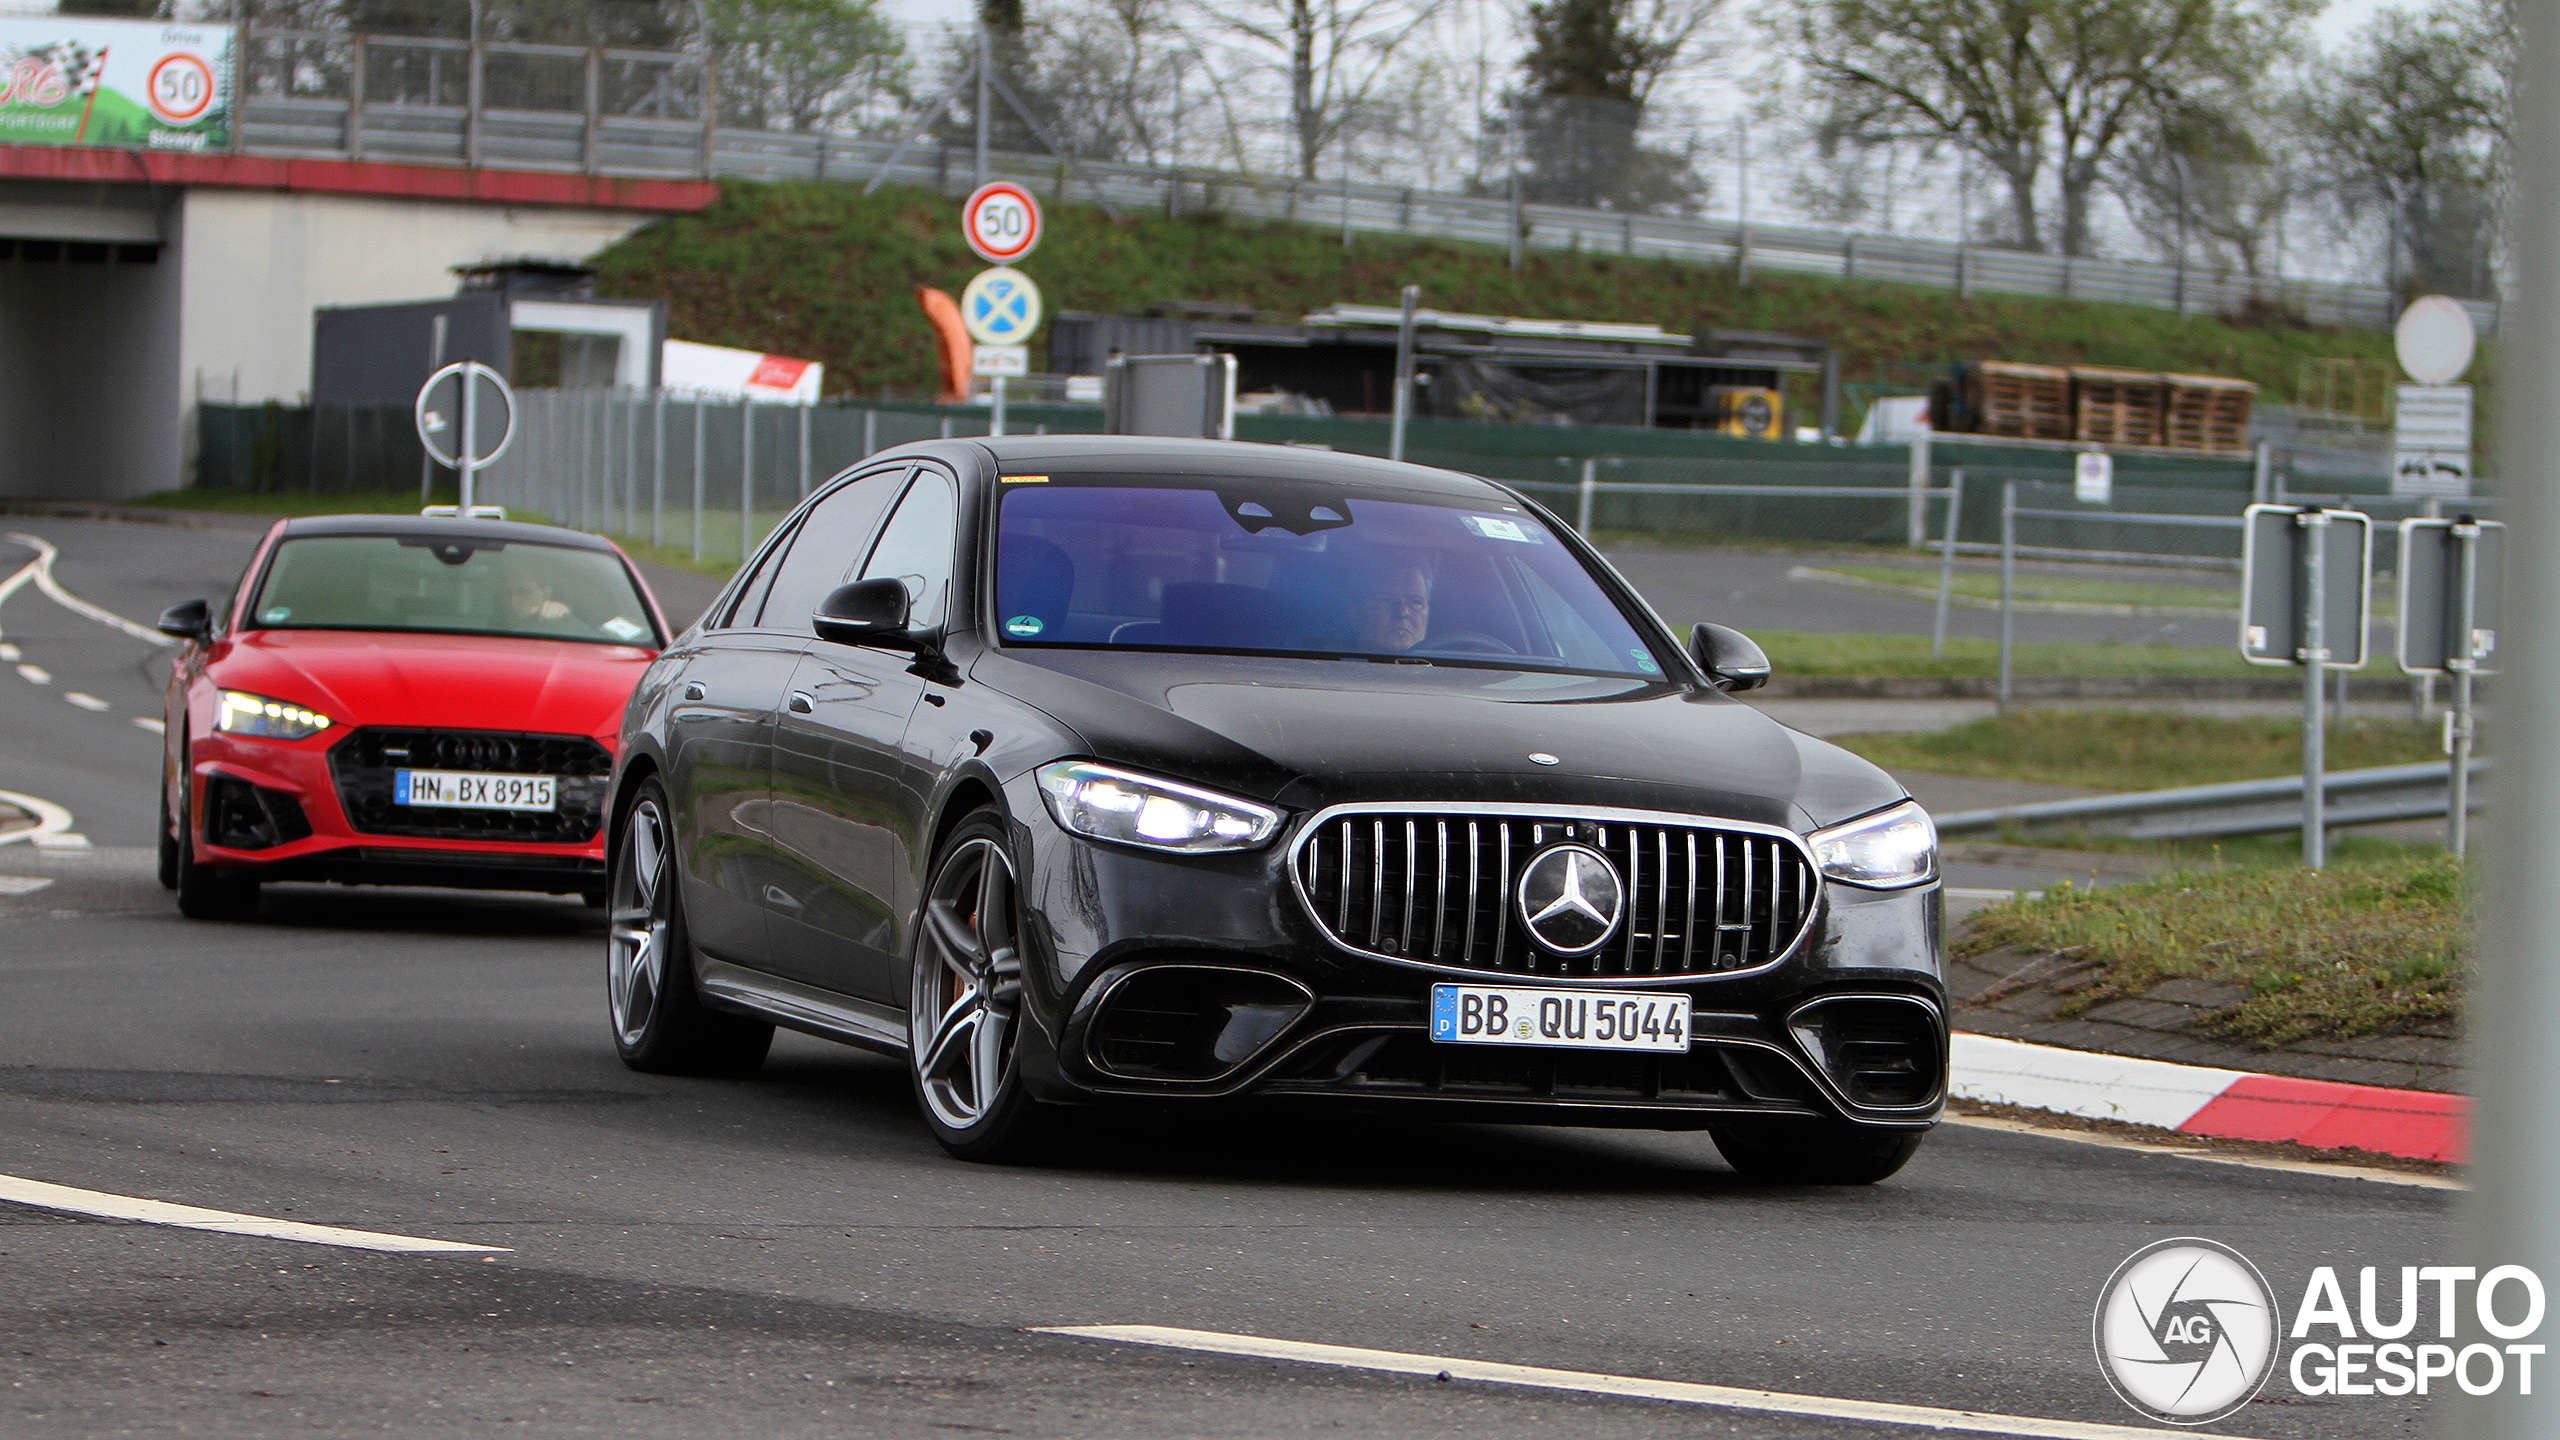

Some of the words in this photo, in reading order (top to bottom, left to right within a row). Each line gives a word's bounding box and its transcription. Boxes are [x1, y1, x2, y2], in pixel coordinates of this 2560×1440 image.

[162, 70, 199, 101] 50
[984, 205, 1022, 236] 50
[412, 776, 441, 800] HN
[459, 778, 489, 802] BX
[495, 779, 551, 805] 8915
[1439, 1019, 1450, 1032] D
[1461, 994, 1509, 1036] BB
[1540, 997, 1587, 1039] QU
[1596, 1000, 1683, 1042] 5044
